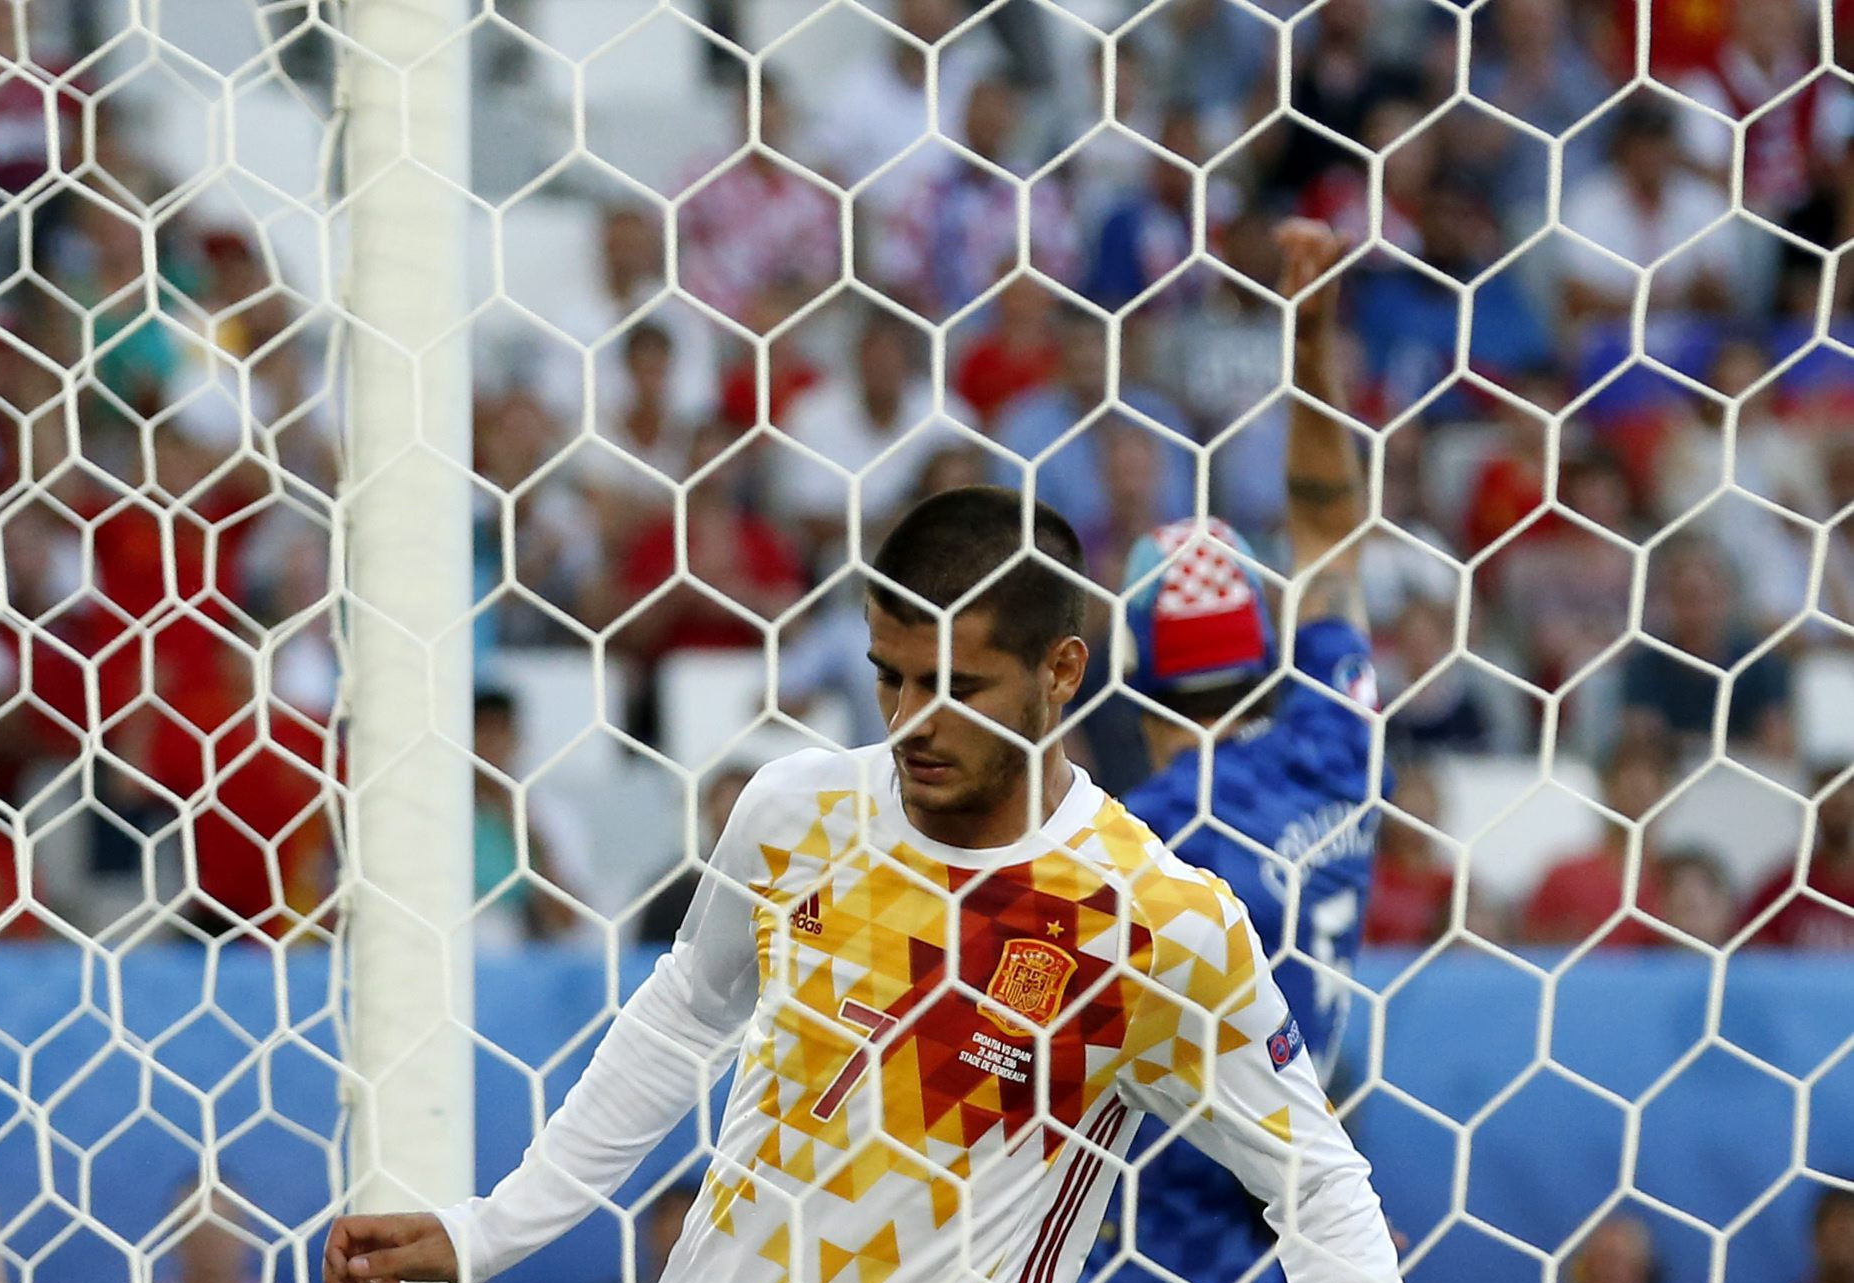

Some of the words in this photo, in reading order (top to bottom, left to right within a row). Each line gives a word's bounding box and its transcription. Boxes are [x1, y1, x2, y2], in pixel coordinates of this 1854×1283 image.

[810, 997, 900, 1123] 7
[972, 1031, 1002, 1052] CROATIA
[1001, 1043, 1012, 1056] VS
[1010, 1047, 1033, 1063] SPAIN
[984, 1050, 1004, 1065] JUNE
[958, 1050, 983, 1069] STADE
[980, 1060, 992, 1073] DE
[990, 1063, 1027, 1083] BORDEAUX
